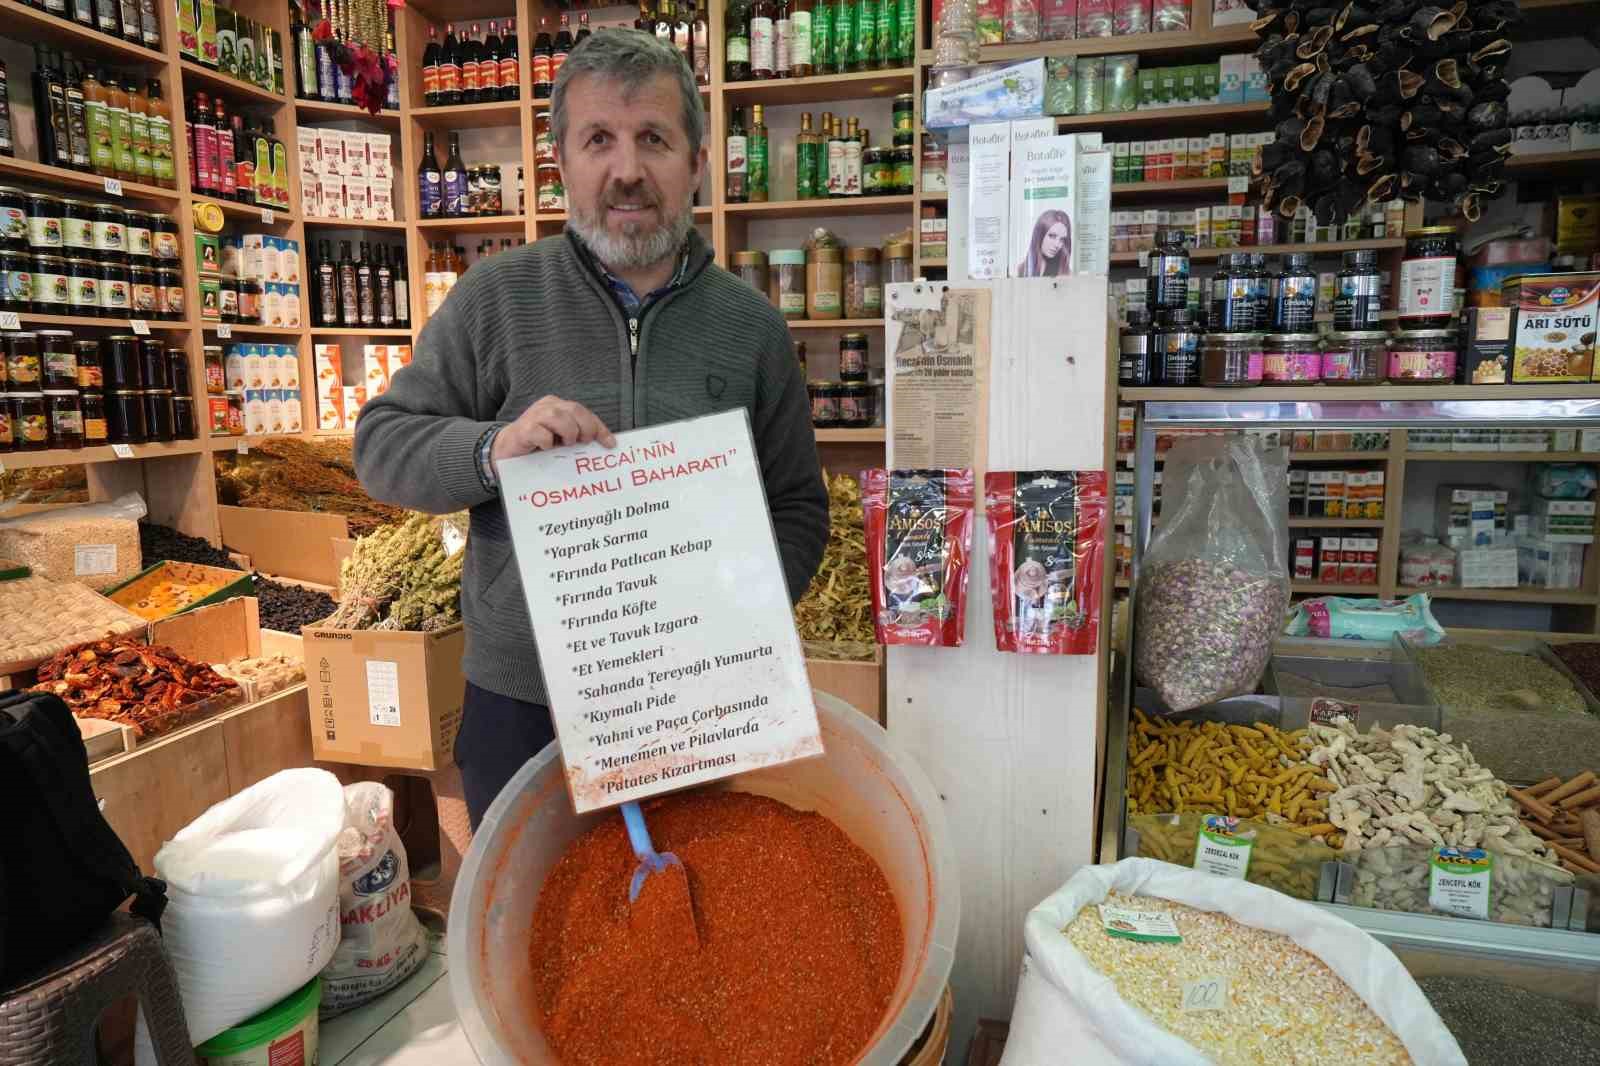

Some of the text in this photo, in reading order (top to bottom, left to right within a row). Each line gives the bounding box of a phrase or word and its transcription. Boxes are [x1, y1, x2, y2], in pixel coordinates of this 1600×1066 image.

[1524, 314, 1591, 329] ARI SÜTÜ
[625, 498, 670, 519] Dolma
[603, 528, 648, 549] Sarma
[611, 548, 667, 573] Patlıcan
[670, 537, 713, 558] Kebap
[616, 574, 658, 595] Tavuk
[621, 598, 657, 621] Köfte
[314, 631, 353, 640] GRUNDIG
[590, 636, 606, 649] ve
[609, 624, 651, 645] Tavuk
[653, 613, 699, 636] Izgara
[596, 646, 665, 673] Yemekleri
[648, 660, 711, 685] Tereyağlı
[714, 643, 773, 668] Yumurta
[646, 692, 676, 710] Pide
[637, 723, 653, 736] ve
[656, 715, 689, 735] Paça
[691, 693, 769, 727] Çorbasında
[670, 740, 686, 753] ve
[688, 720, 760, 748] Pilavlarda
[661, 753, 737, 780] Kızartması
